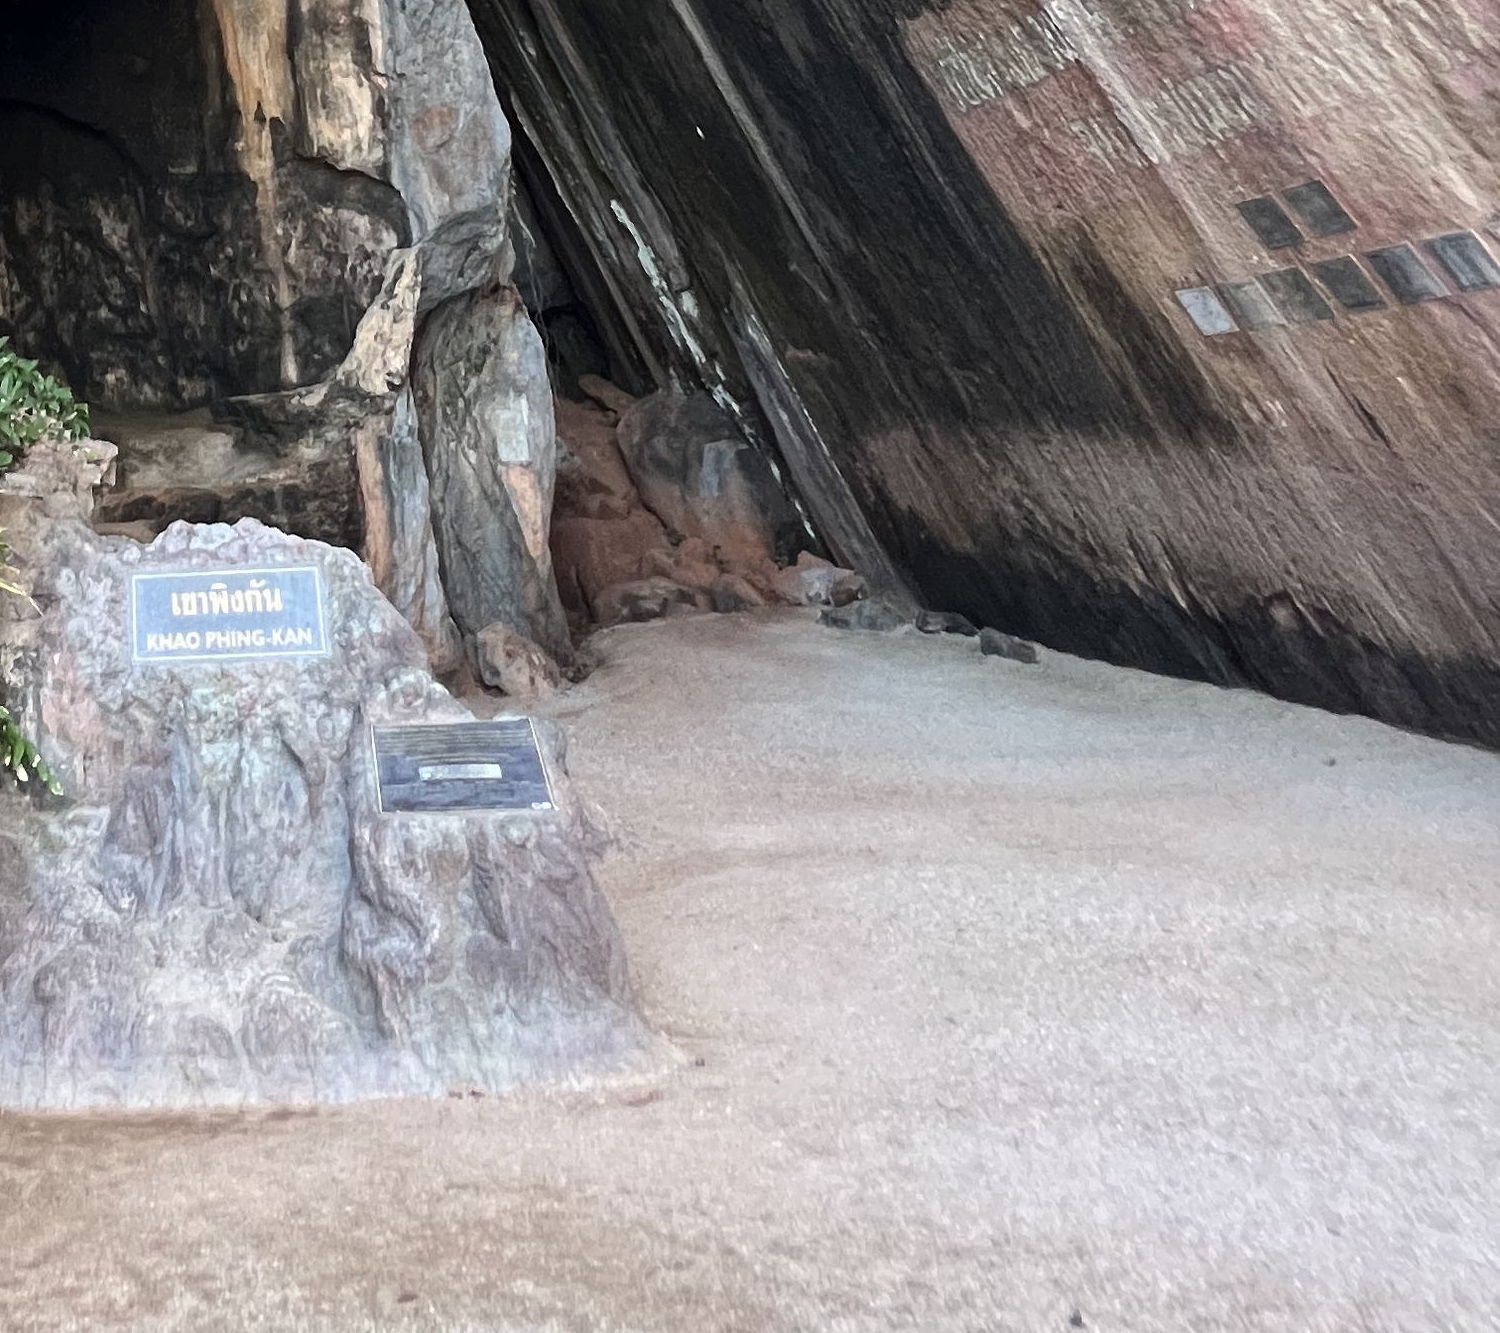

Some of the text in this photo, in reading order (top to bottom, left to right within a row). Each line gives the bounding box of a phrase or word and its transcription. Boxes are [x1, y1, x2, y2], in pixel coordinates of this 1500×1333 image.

[171, 578, 283, 616] เขาพิงกัน
[146, 627, 312, 651] KHAO PHING-KAN
